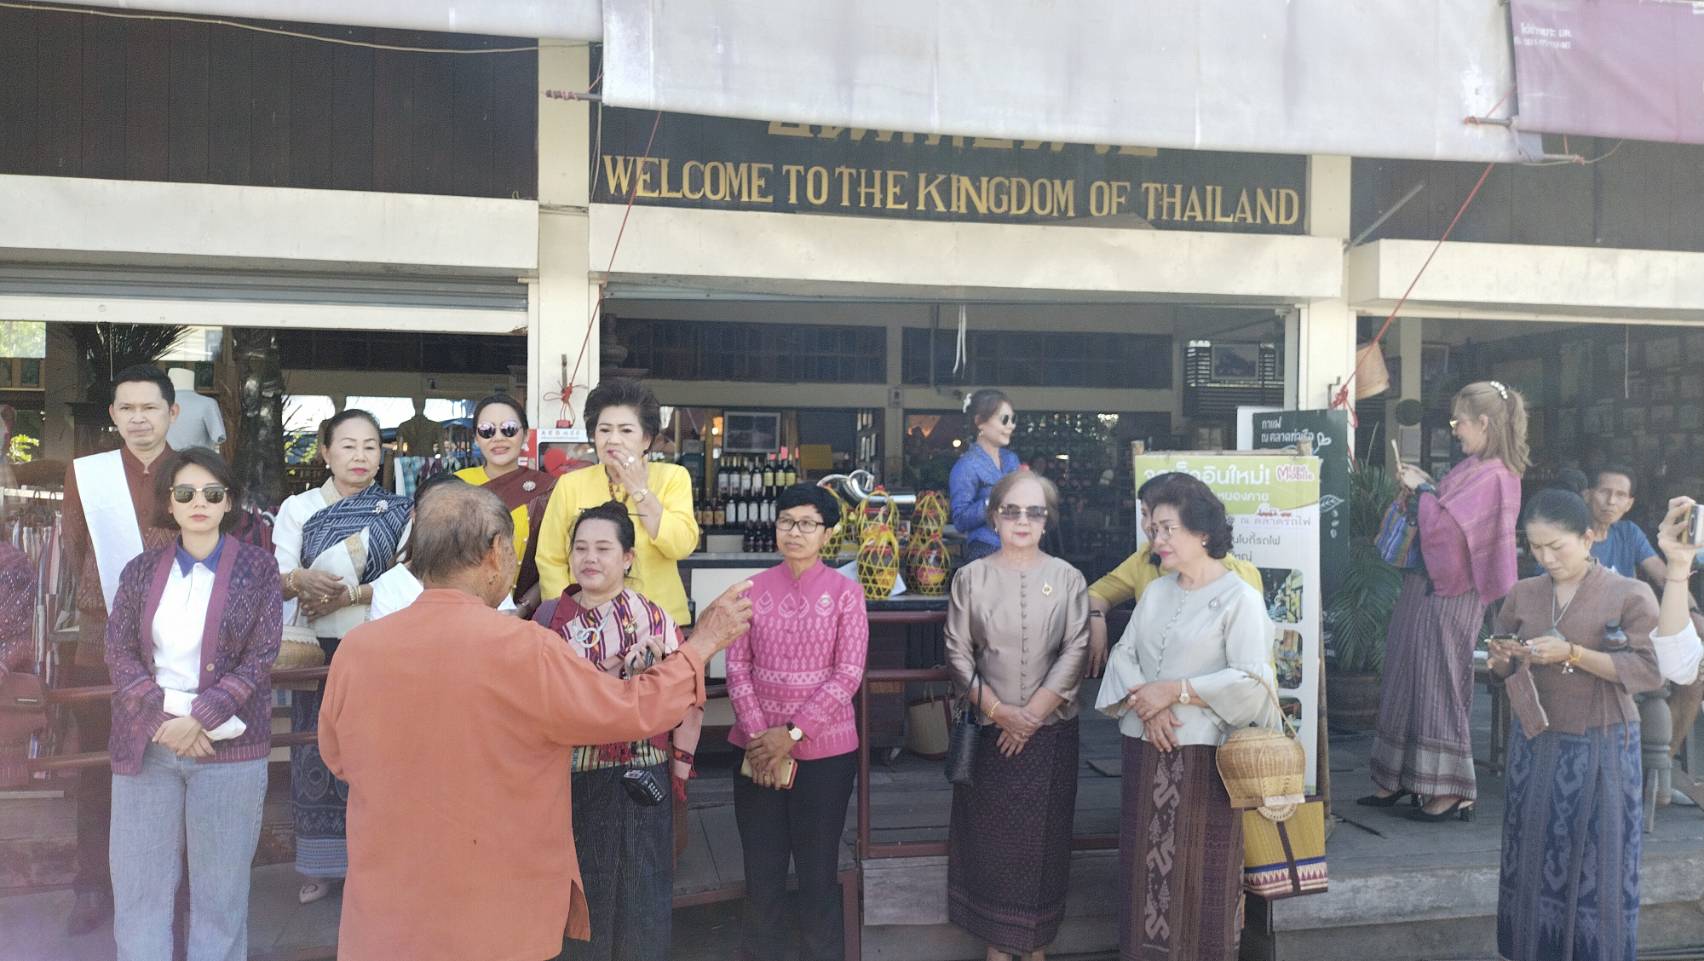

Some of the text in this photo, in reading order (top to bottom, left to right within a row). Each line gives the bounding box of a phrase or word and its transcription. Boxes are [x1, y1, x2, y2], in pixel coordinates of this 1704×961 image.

[603, 155, 1299, 226] WELCOME TO THE KINGDOM OF THAILAND
